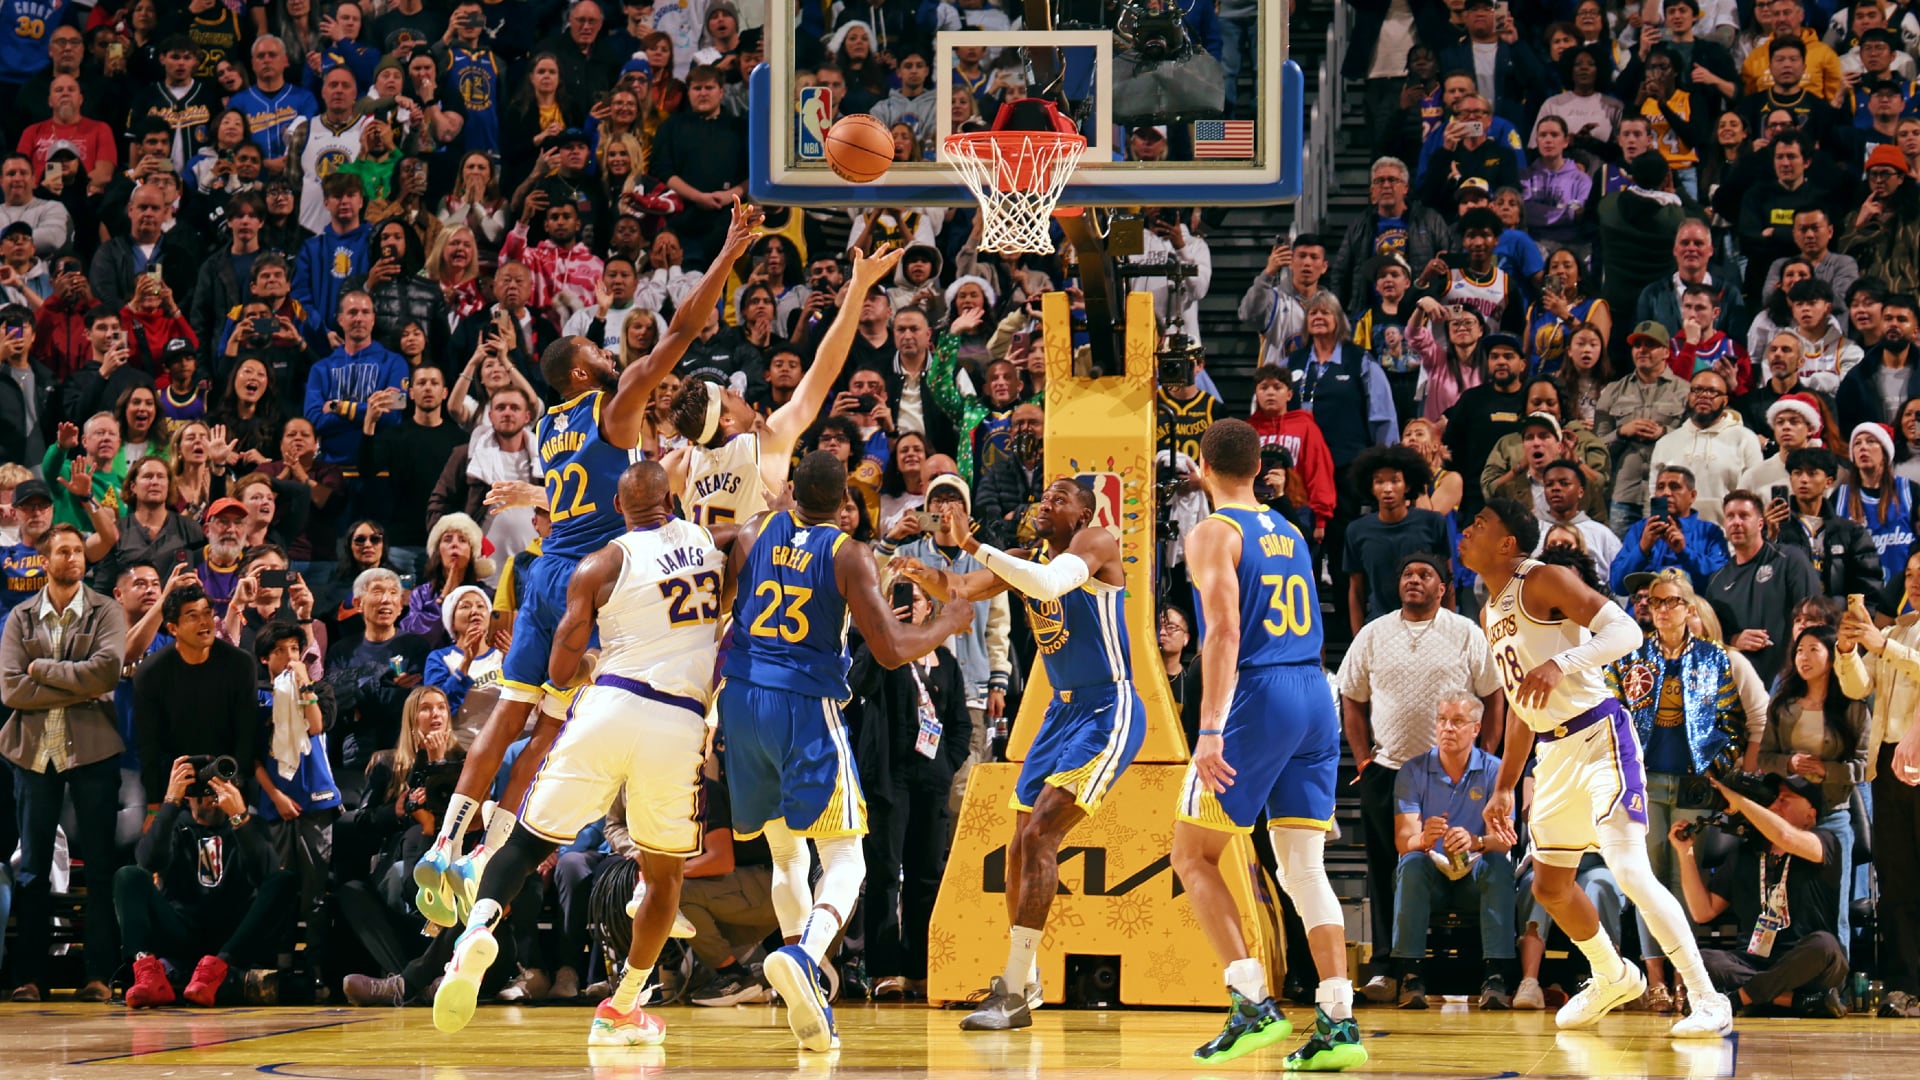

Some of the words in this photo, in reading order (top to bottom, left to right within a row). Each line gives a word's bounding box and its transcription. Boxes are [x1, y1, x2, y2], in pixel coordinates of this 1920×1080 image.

[14, 1, 53, 20] CURRY
[15, 15, 45, 39] 30
[333, 153, 345, 165] 30
[803, 142, 820, 155] NBA
[541, 431, 587, 463] WIGGINS
[545, 462, 597, 522] 22
[695, 472, 742, 498] REAVES
[1258, 536, 1296, 559] CURRY
[1872, 525, 1916, 556] ngeles
[657, 546, 704, 575] JAMES
[772, 545, 814, 574] GREEN
[8, 576, 49, 592] WARRIO
[659, 570, 721, 629] 23
[750, 580, 814, 643] 23
[1260, 574, 1312, 637] 30
[1041, 628, 1071, 655] RIORS
[1489, 614, 1518, 647] KERS
[1495, 644, 1525, 694] 28
[1665, 684, 1681, 696] 30
